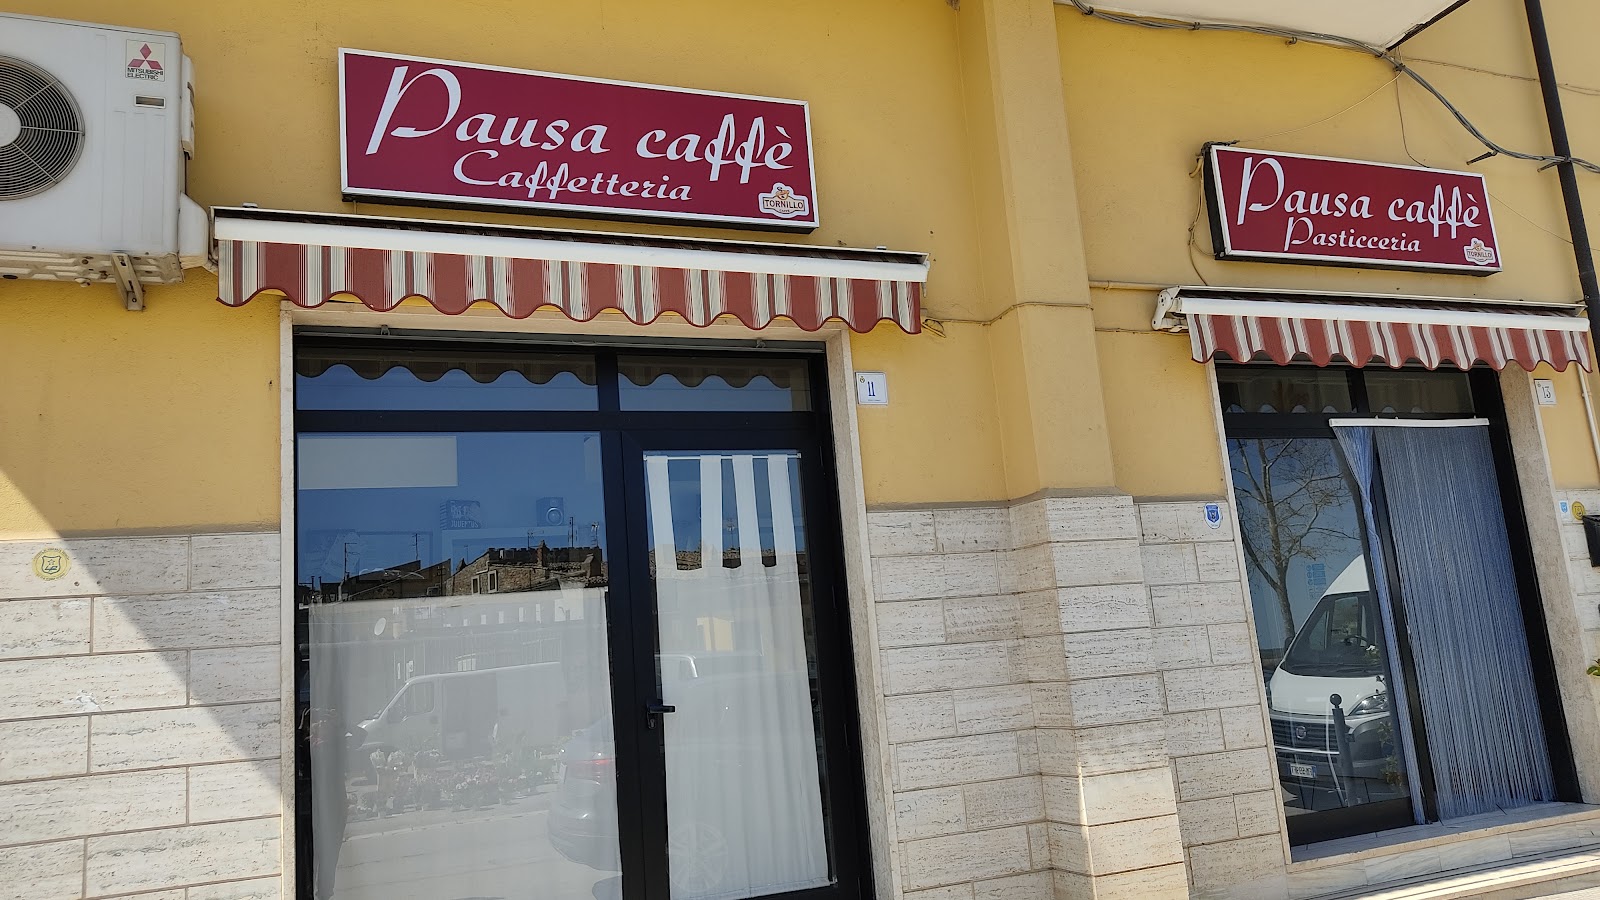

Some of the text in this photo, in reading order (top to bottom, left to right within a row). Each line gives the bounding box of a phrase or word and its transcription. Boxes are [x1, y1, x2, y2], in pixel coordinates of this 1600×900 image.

[127, 67, 163, 75] MITSUBISHI
[365, 65, 794, 184] Pausa caffè
[453, 149, 693, 201] Caffetteria
[764, 199, 804, 209] TORNILLO
[1236, 156, 1482, 239] Pausa caffè
[1283, 216, 1422, 252] Pasticceria
[1467, 250, 1492, 258] TORNILLO
[867, 381, 876, 397] 11
